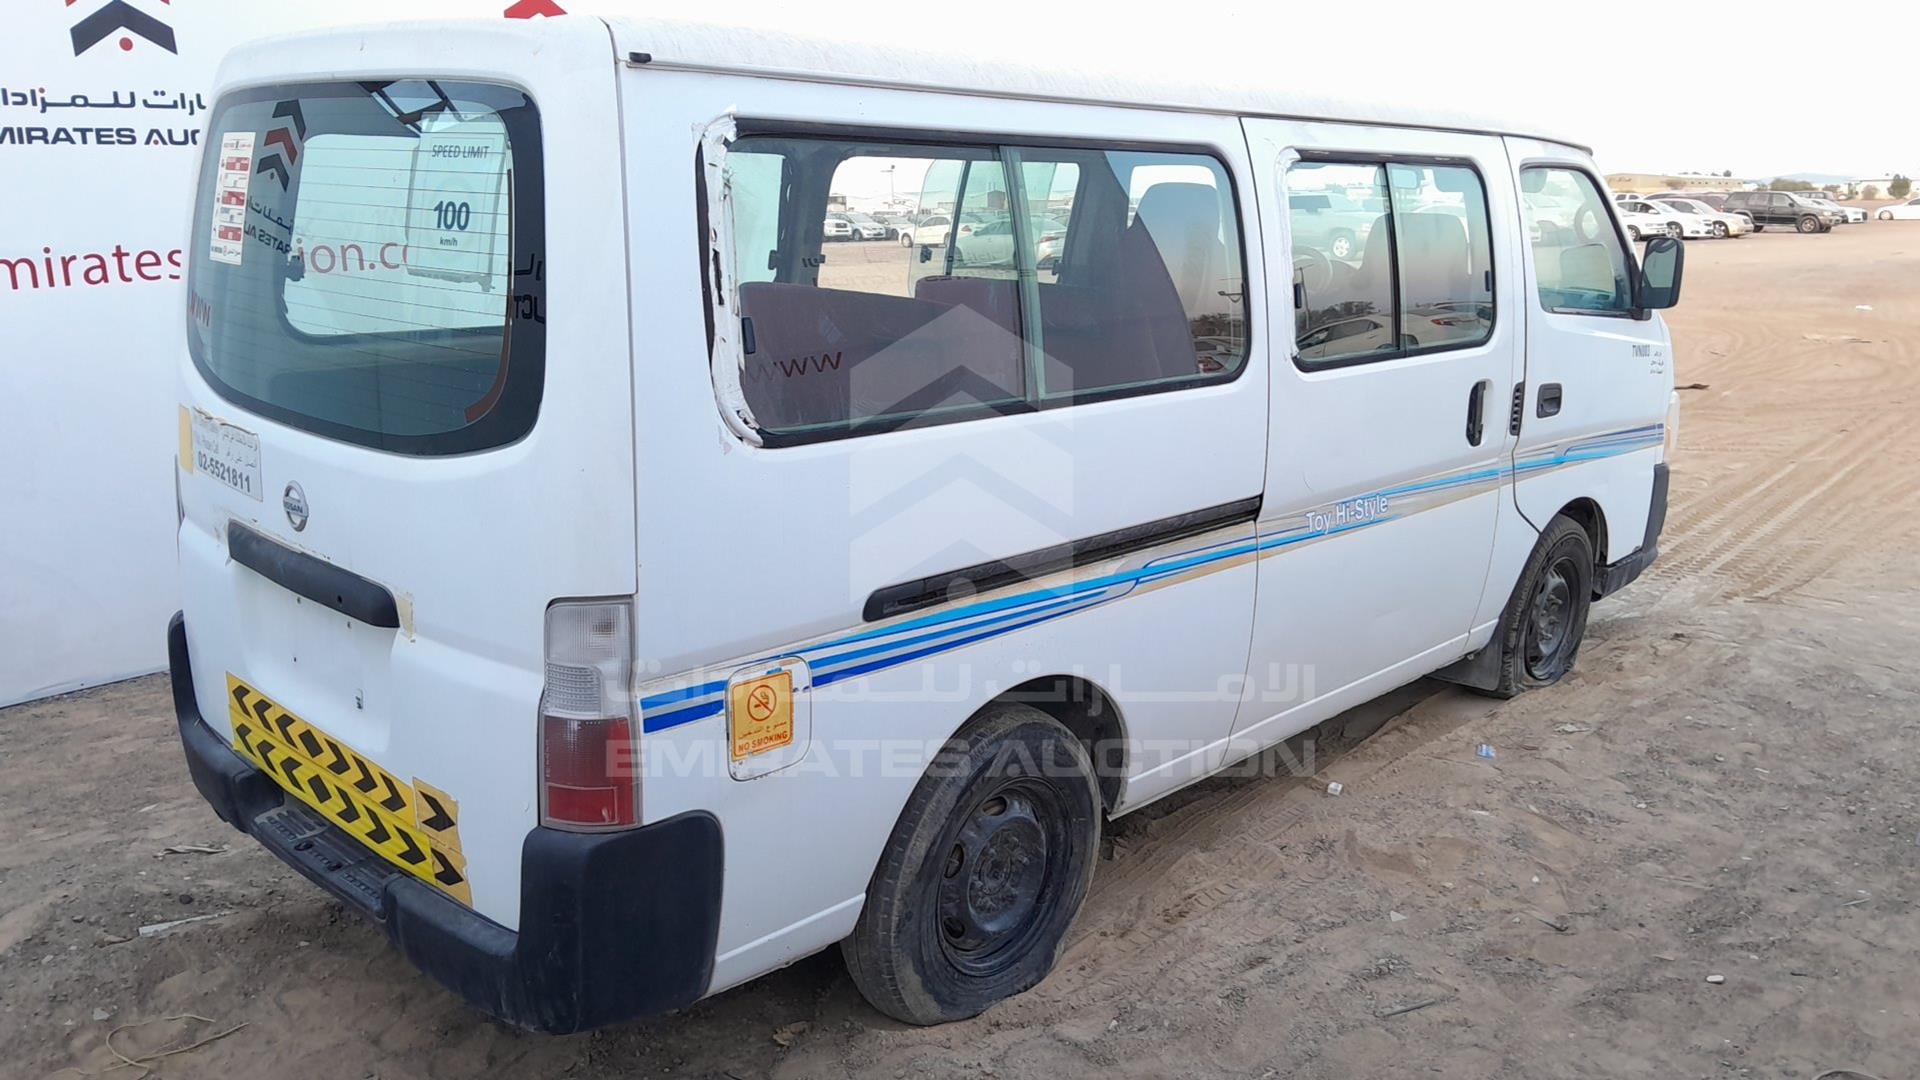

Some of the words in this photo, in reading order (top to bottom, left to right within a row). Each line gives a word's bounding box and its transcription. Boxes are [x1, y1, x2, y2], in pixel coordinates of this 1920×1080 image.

[432, 144, 460, 158] SPEED
[462, 146, 490, 159] LIMIT
[433, 200, 470, 231] 100
[439, 236, 458, 247] km/h
[198, 450, 251, 493] 02-5521811
[1306, 510, 1331, 535] Toy
[1336, 495, 1388, 525] Hi-Style
[738, 742, 750, 753] NO
[751, 730, 788, 749] SMOKING
